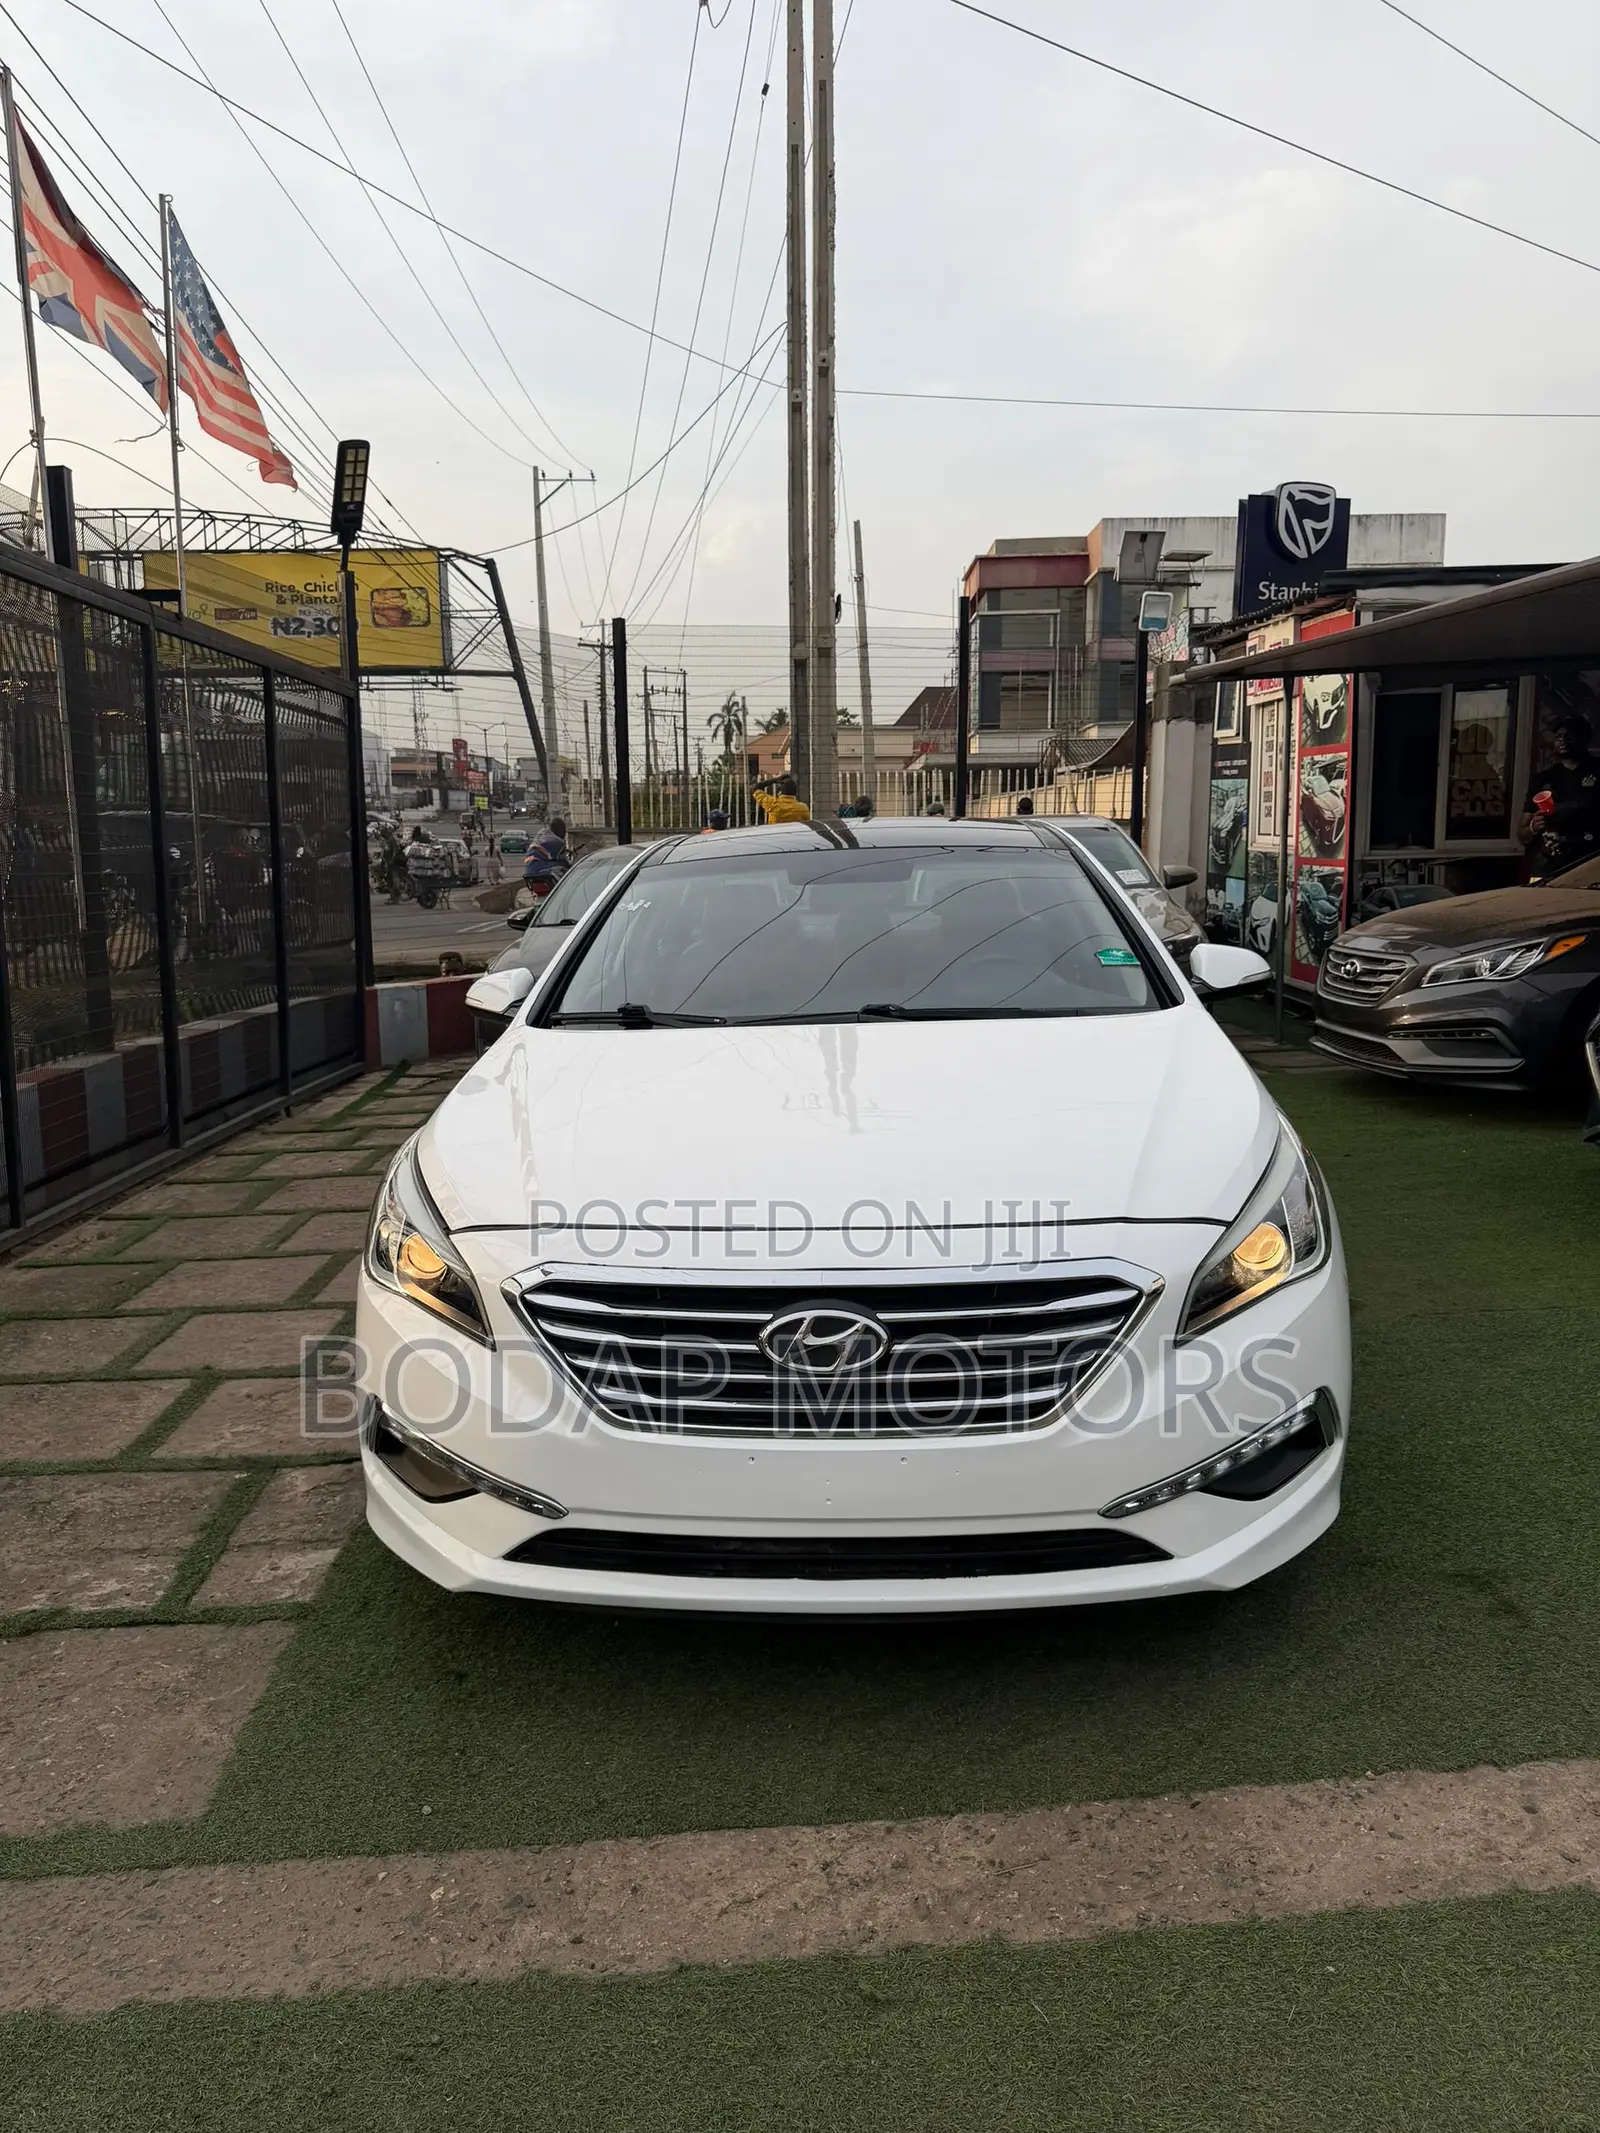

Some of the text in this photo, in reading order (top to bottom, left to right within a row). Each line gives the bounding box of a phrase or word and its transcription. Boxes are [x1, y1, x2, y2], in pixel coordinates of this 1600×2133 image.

[265, 581, 359, 593] Rice, Chicn
[1258, 581, 1319, 600] Stanbi
[276, 594, 341, 604] & Planta
[1452, 781, 1504, 800] CAR
[1451, 801, 1504, 817] PLUG
